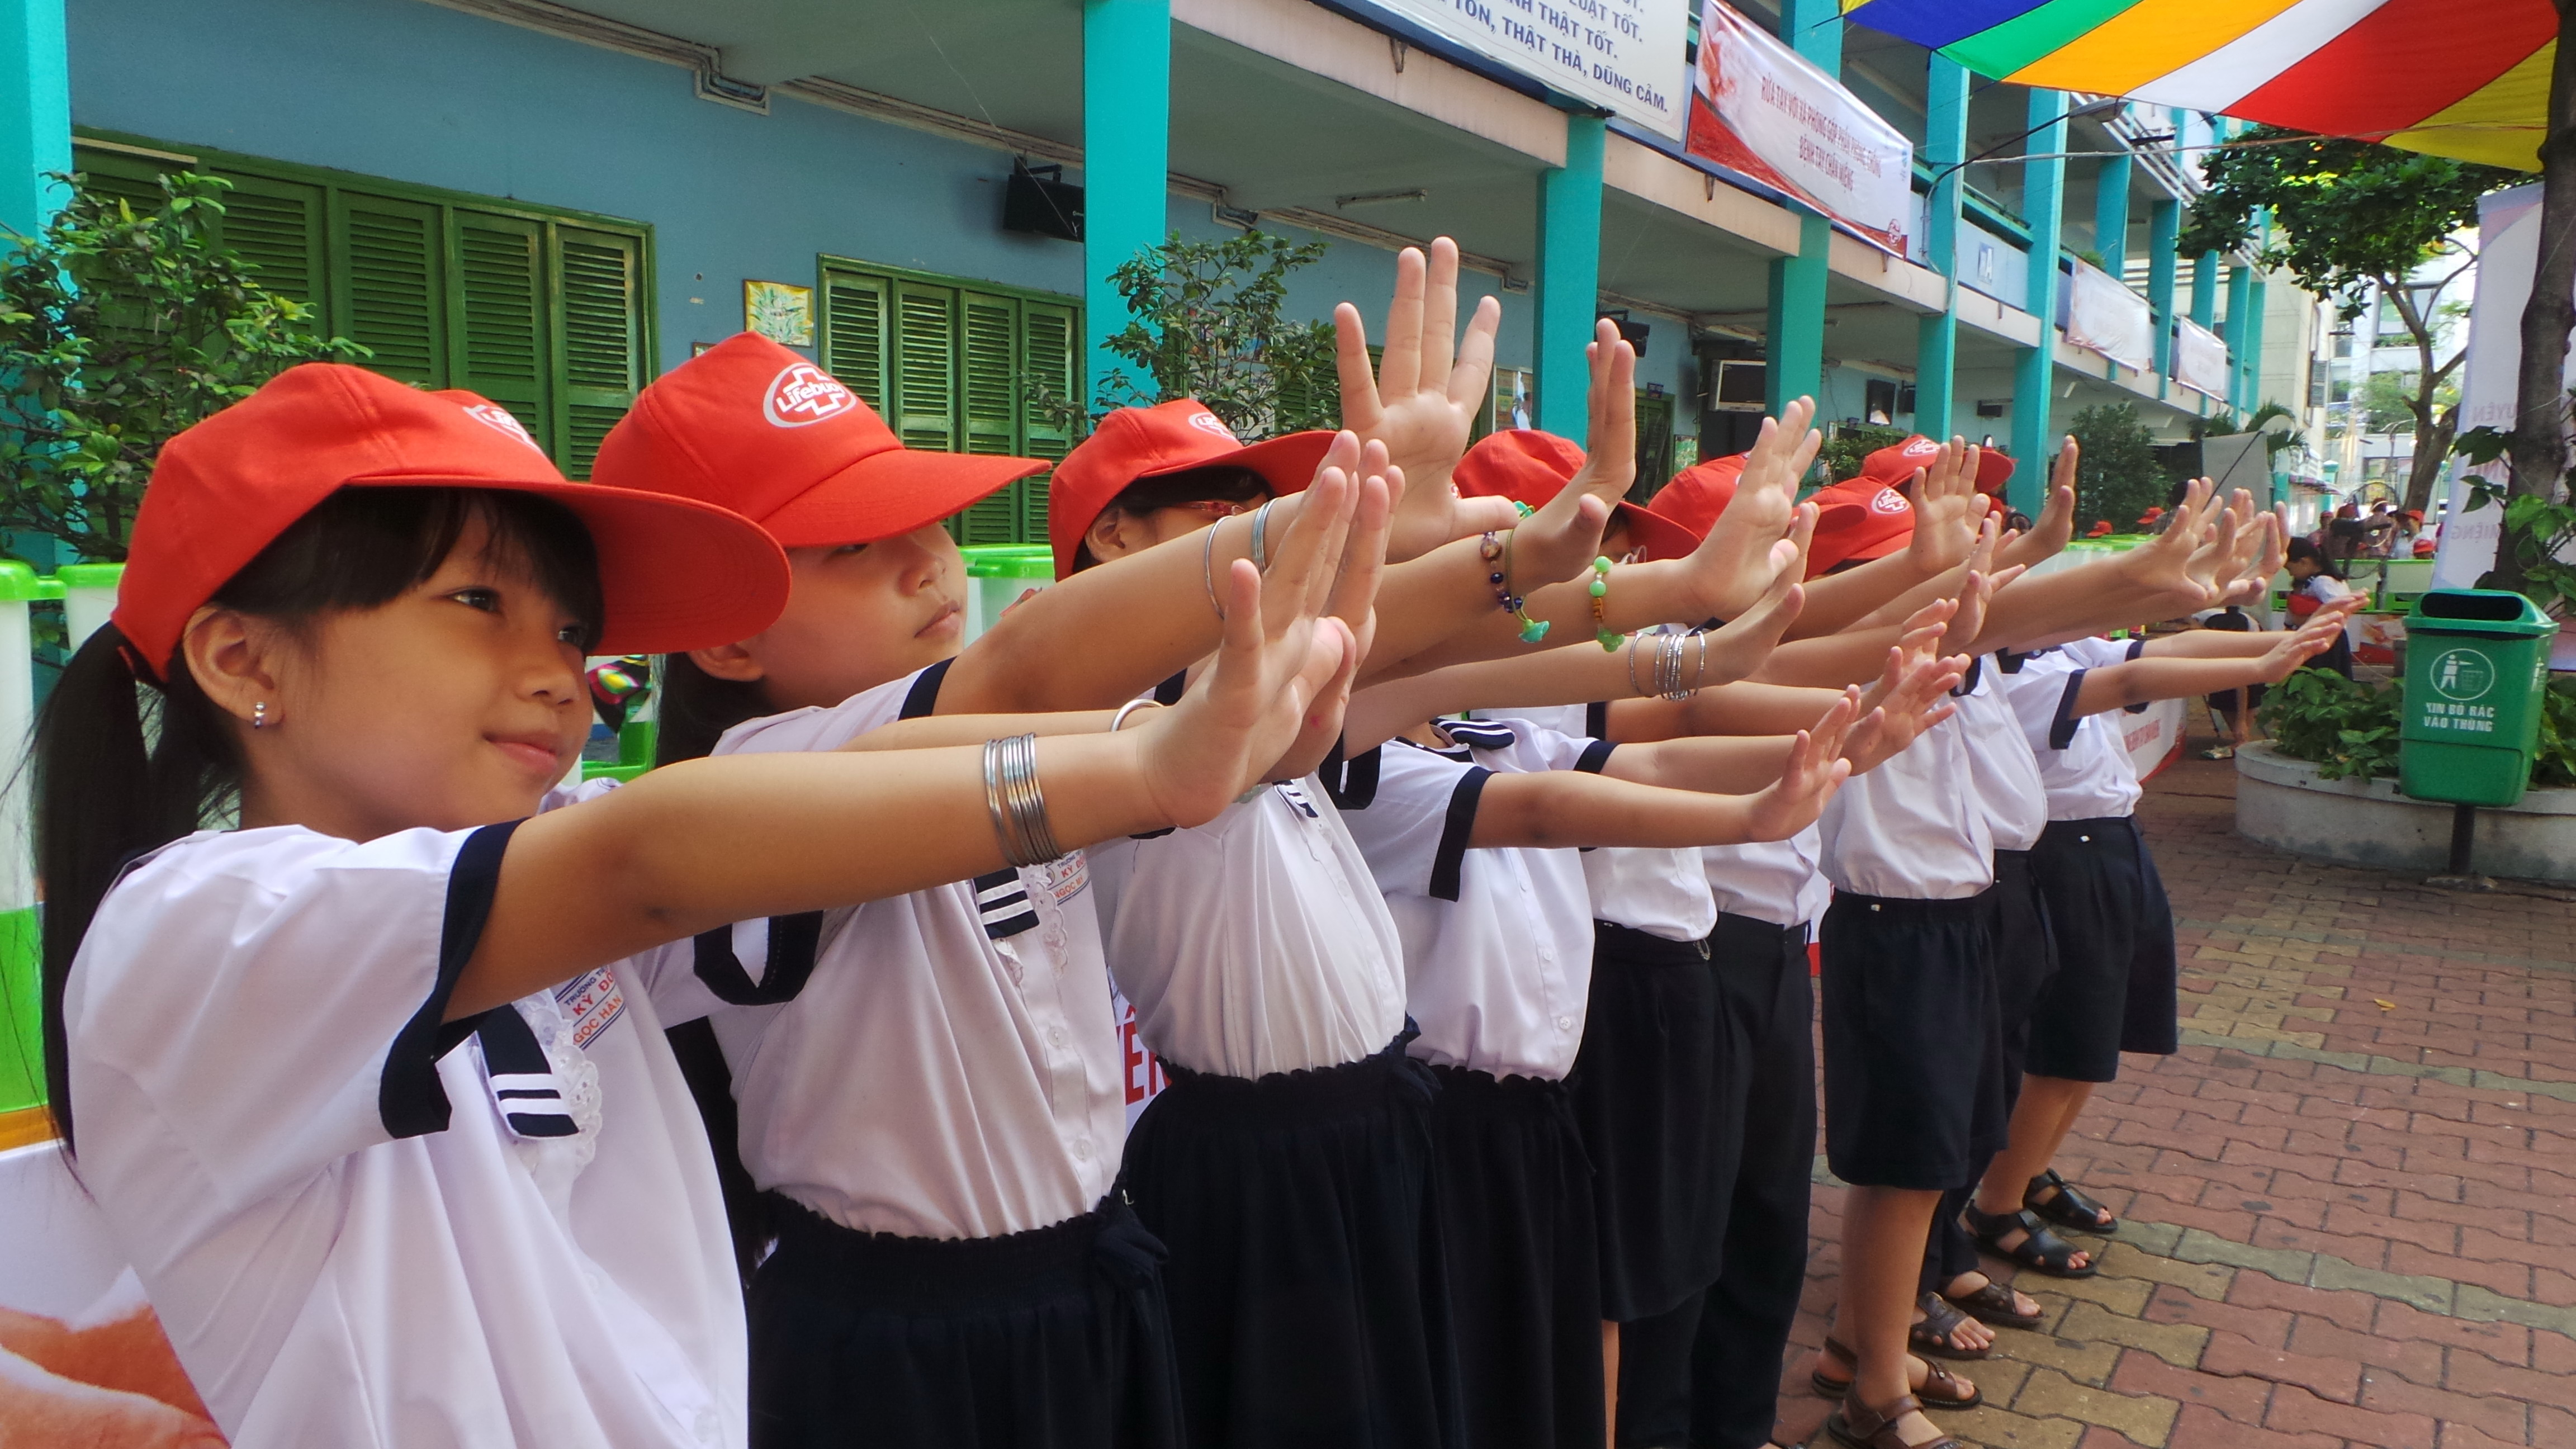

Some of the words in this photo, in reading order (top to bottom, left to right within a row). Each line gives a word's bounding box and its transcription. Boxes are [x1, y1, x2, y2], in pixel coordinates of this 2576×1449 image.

[1538, 2, 1579, 37] THẬT
[1585, 28, 1618, 58] TỐT.
[1612, 11, 1643, 42] TỐT.
[1502, 16, 1546, 51] THẬT
[1552, 42, 1587, 77] THÀ,
[1593, 63, 1631, 94] DŨNG
[1636, 83, 1668, 112] CẢM.
